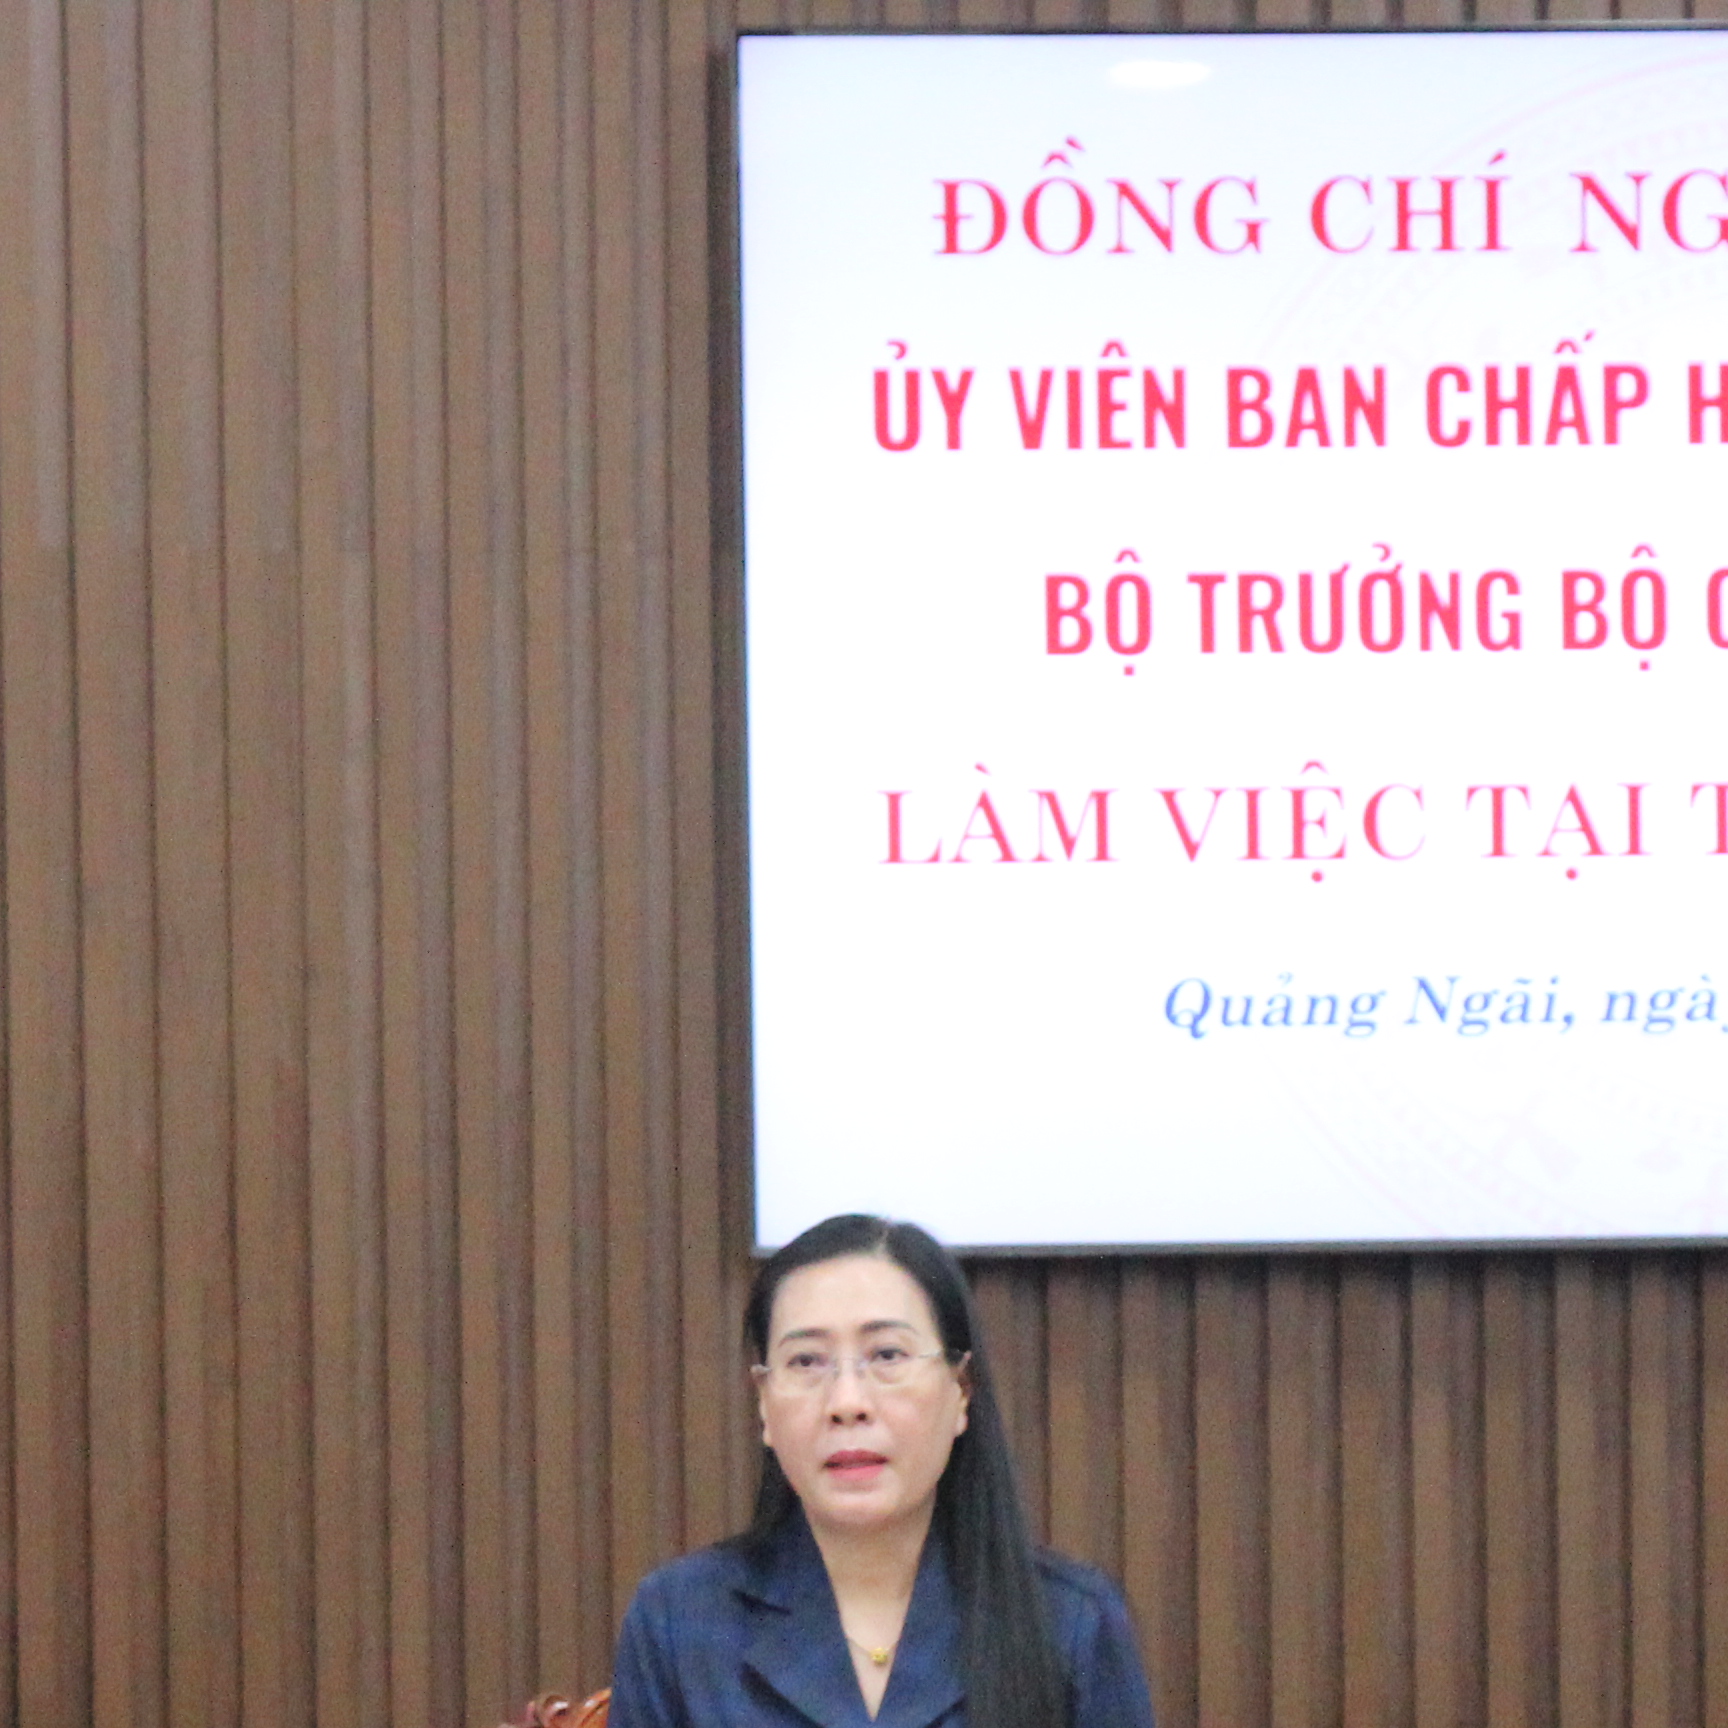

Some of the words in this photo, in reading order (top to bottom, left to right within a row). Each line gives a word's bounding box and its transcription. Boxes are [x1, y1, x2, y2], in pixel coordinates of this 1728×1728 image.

[932, 136, 1269, 256] ĐỒNG
[1310, 151, 1512, 253] CHÍ
[873, 341, 975, 452] ỦY
[1008, 341, 1187, 450] VIÊN
[1225, 366, 1388, 448] BAN
[1424, 331, 1651, 446] CHẤP
[1044, 549, 1153, 676] BỘ
[1187, 543, 1522, 654] TRƯỞNG
[1560, 545, 1668, 670] BỘ
[878, 763, 1119, 864] LÀM
[1152, 760, 1427, 883] VIỆC
[1465, 783, 1654, 880] TẠI
[1161, 972, 1386, 1038] Quảng
[1403, 975, 1575, 1037] Ngãi,
